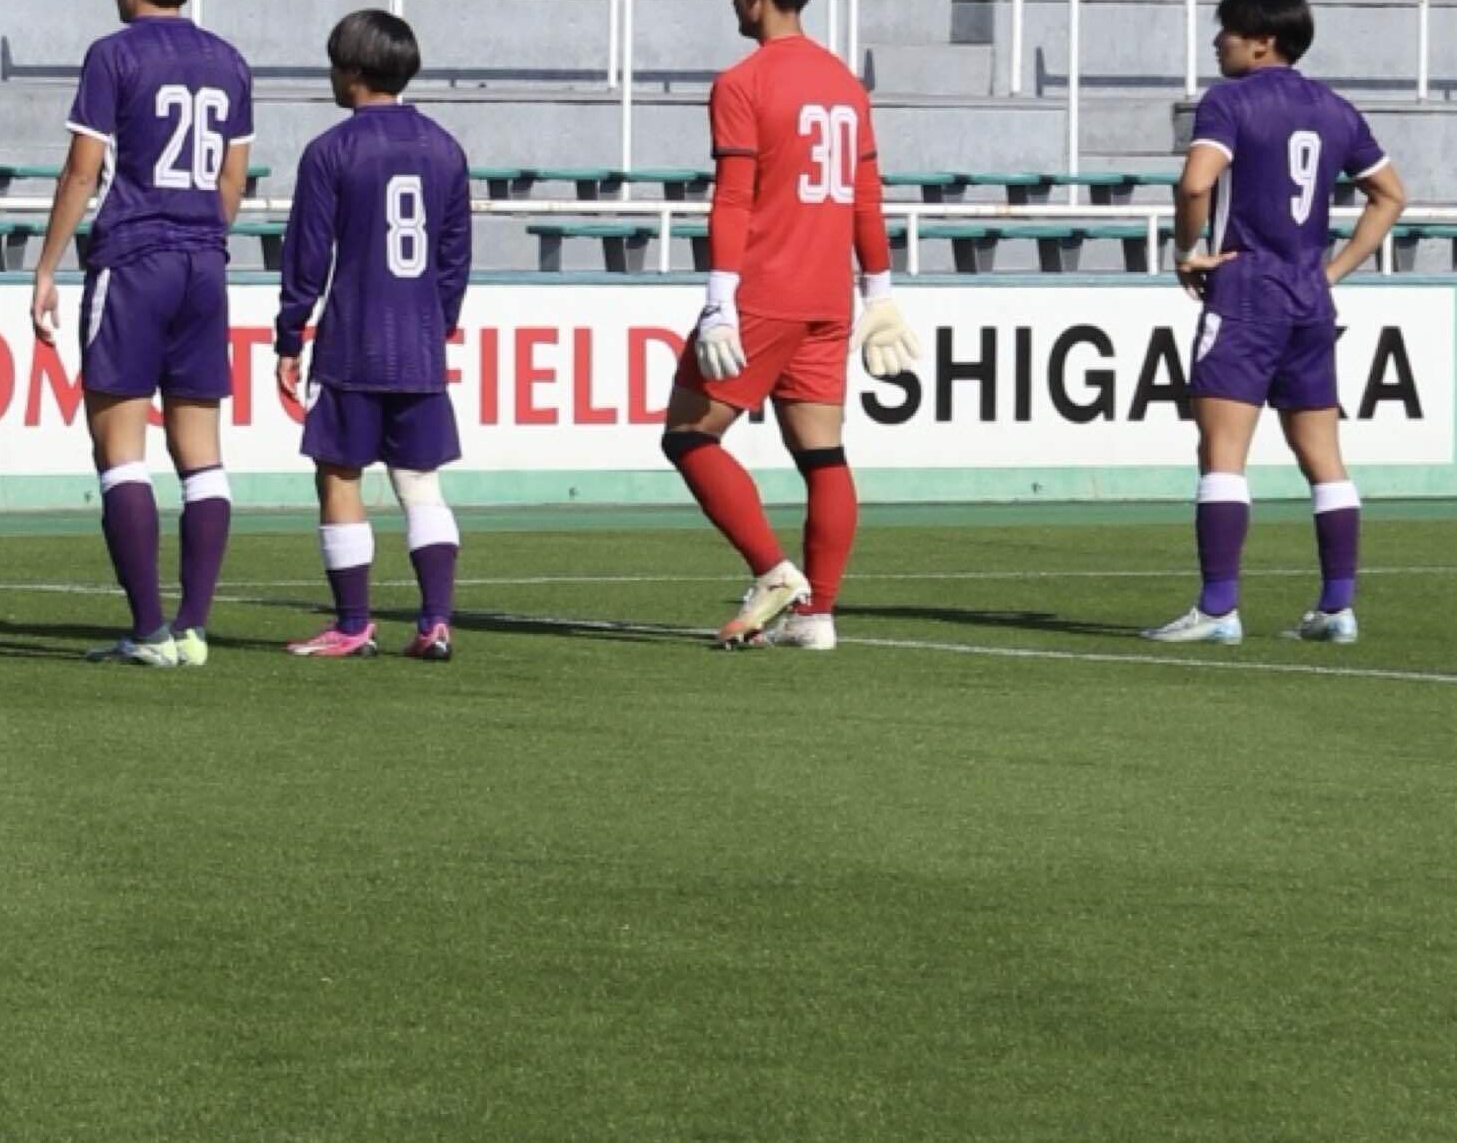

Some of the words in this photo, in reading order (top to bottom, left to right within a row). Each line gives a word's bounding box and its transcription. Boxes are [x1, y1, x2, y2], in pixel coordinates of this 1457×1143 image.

[153, 84, 229, 191] 26
[796, 104, 858, 205] 30
[1289, 130, 1323, 226] 9
[385, 175, 428, 279] 8
